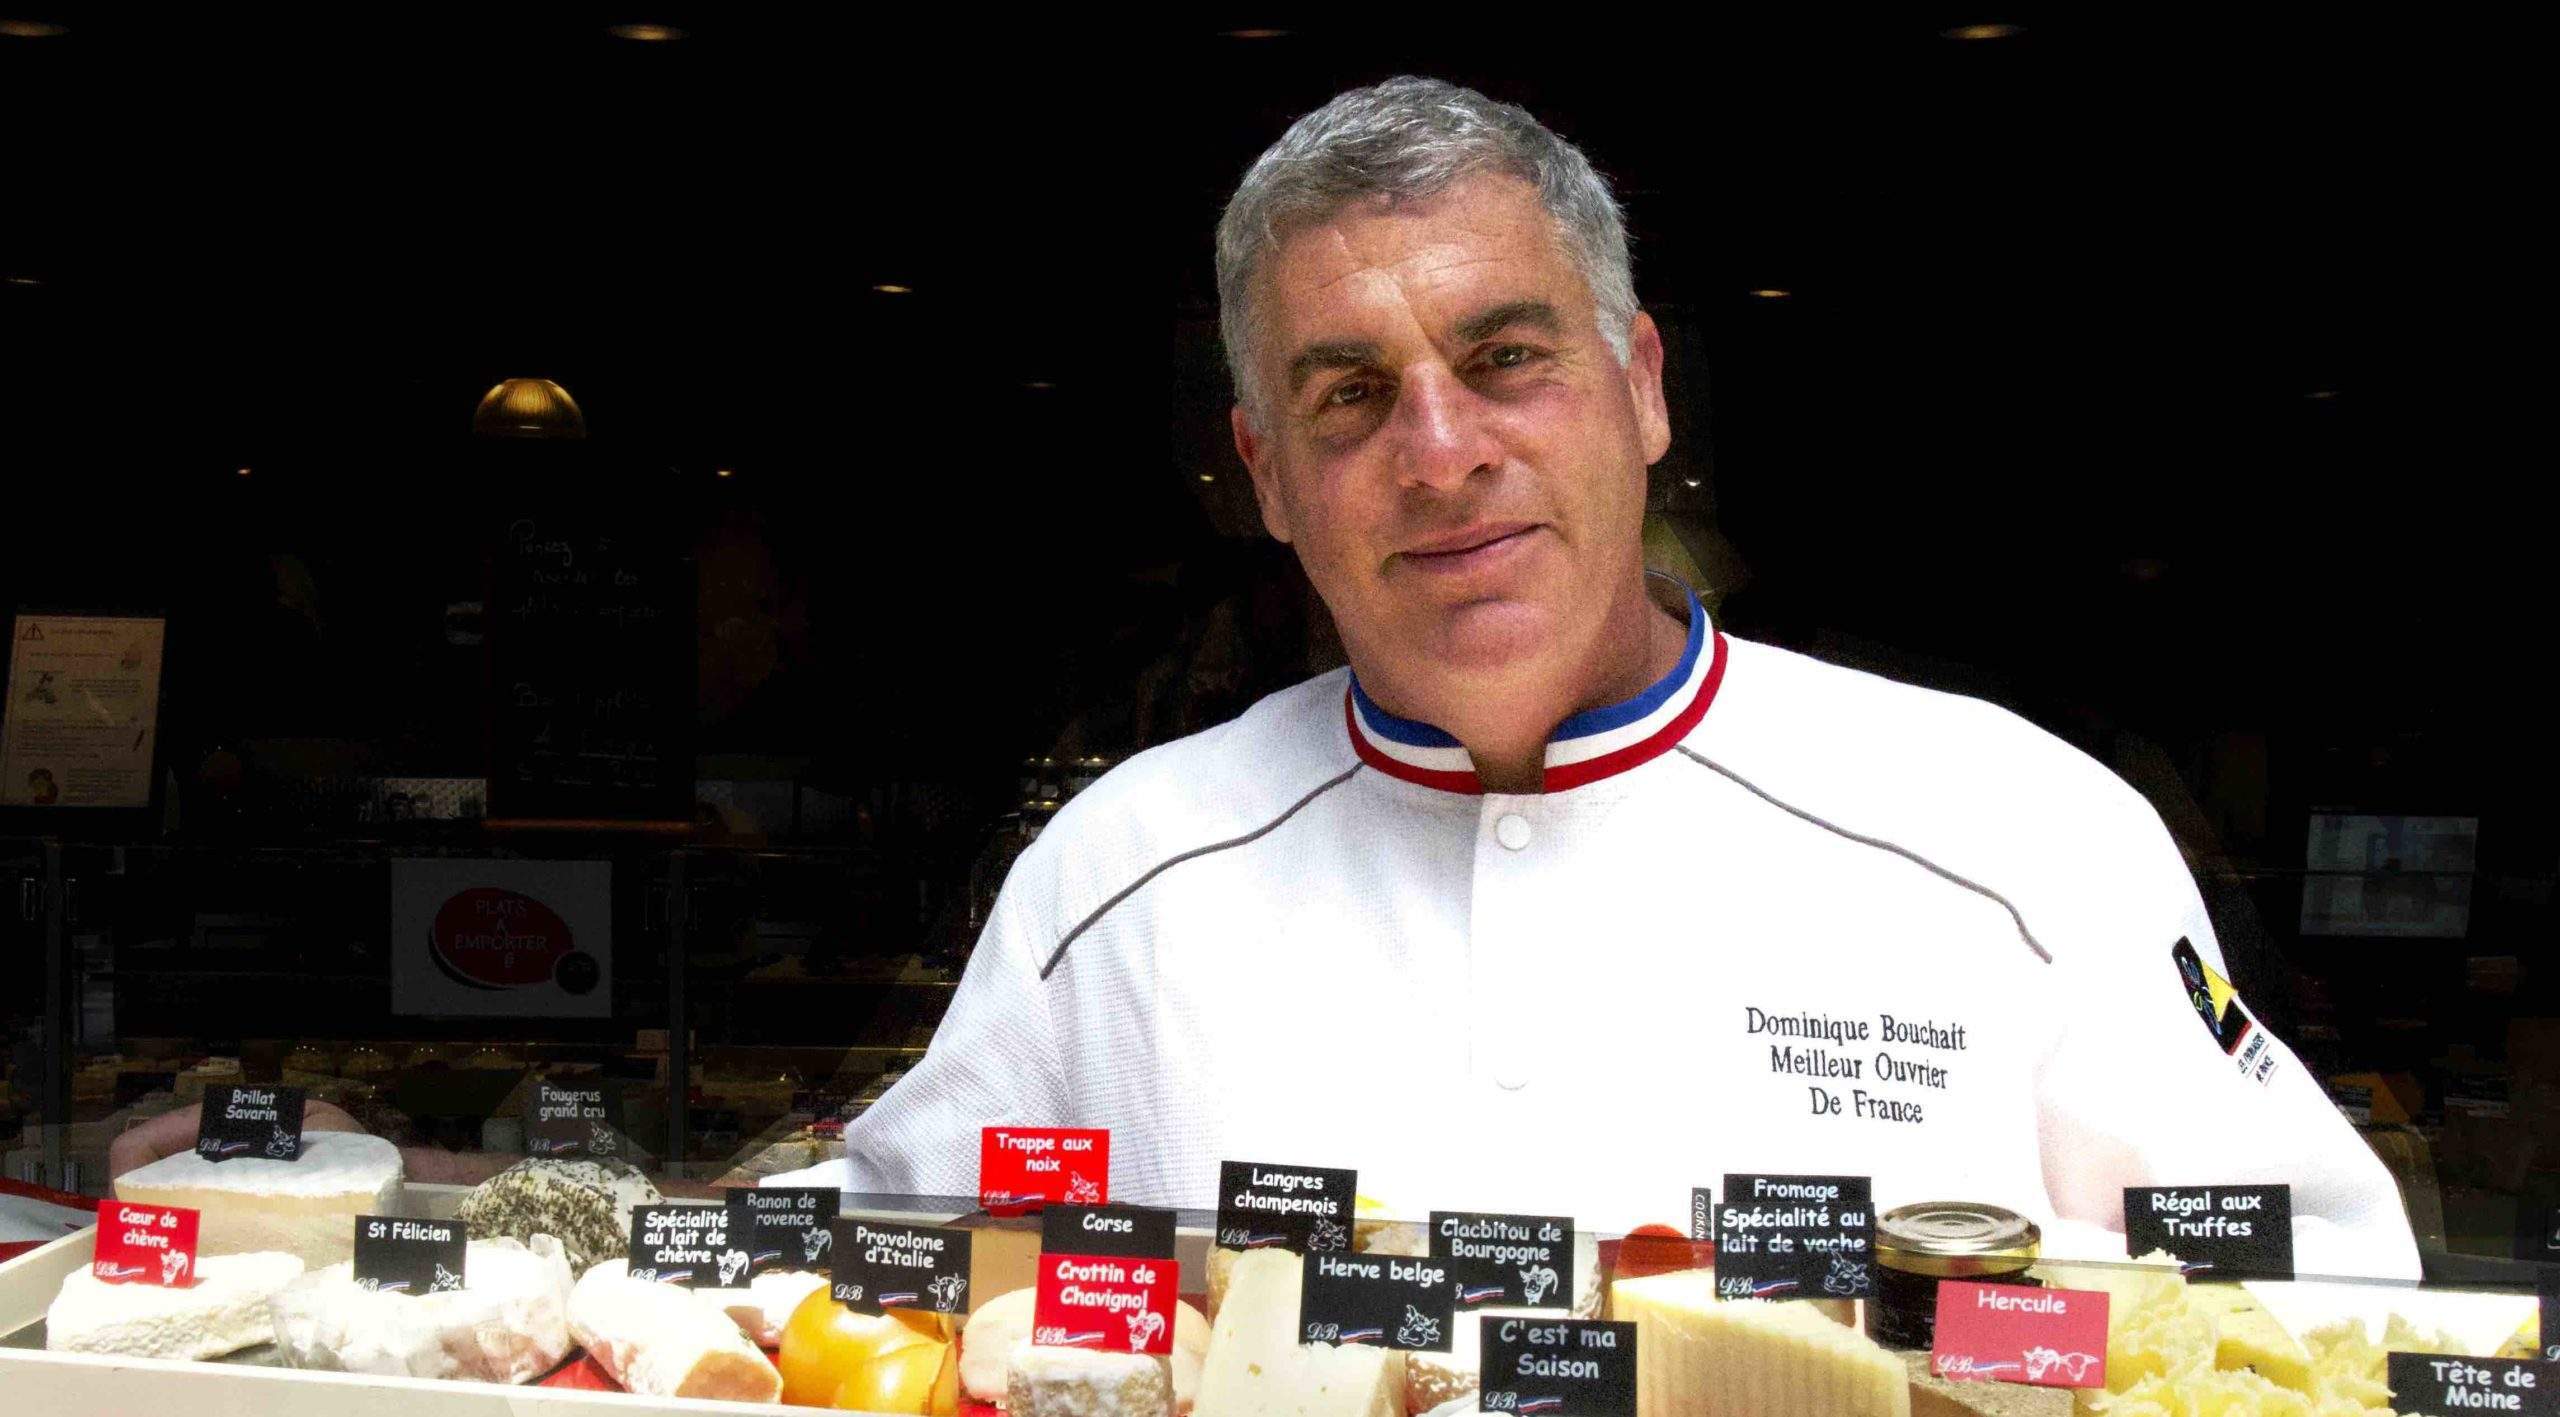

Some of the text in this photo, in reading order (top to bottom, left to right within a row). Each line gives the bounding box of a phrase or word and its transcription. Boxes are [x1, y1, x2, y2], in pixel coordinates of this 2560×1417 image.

[1745, 1006, 1967, 1051] Dominique Bouchait
[1770, 1044, 1948, 1090] Meilleur Ouvrier
[232, 1089, 276, 1106] Brillat
[541, 1086, 601, 1106] Fougerus
[1809, 1087, 1924, 1124] De France
[225, 1105, 278, 1120] Savarin
[540, 1104, 606, 1122] grand cru
[996, 1133, 1093, 1153] Trappe aux
[1026, 1156, 1060, 1172] noix
[1252, 1168, 1324, 1193] Langres
[1754, 1178, 1839, 1203] Fromage
[797, 1192, 817, 1209] de
[1235, 1190, 1338, 1215] champenois
[2152, 1191, 2262, 1217] Régal aux
[160, 1211, 178, 1228] de
[645, 1209, 729, 1232] Spécialité
[756, 1214, 815, 1226] rovence
[1082, 1213, 1133, 1232] Corse
[1440, 1218, 1562, 1242] Clacbitou de
[1722, 1206, 1866, 1232] Spécialité au
[2163, 1217, 2253, 1237] Truffes
[123, 1229, 169, 1248] chèvre
[368, 1222, 451, 1242] St Félicien
[643, 1228, 727, 1246] au lait de
[856, 1225, 944, 1252] Provolone
[1722, 1233, 1866, 1253] lait de vache
[654, 1245, 712, 1264] chèvre
[865, 1246, 935, 1269] d'Italie
[1452, 1239, 1551, 1265] Bourgogne
[1056, 1260, 1156, 1284] Crottin de
[1319, 1257, 1445, 1288] Herve belge
[1060, 1286, 1149, 1312] Chavignol
[1978, 1289, 2067, 1314] Hercule
[1500, 1320, 1616, 1348] C'est ma
[1516, 1353, 1600, 1379] Saison
[2429, 1360, 2536, 1388] Tête de
[2445, 1385, 2522, 1411] Moine
